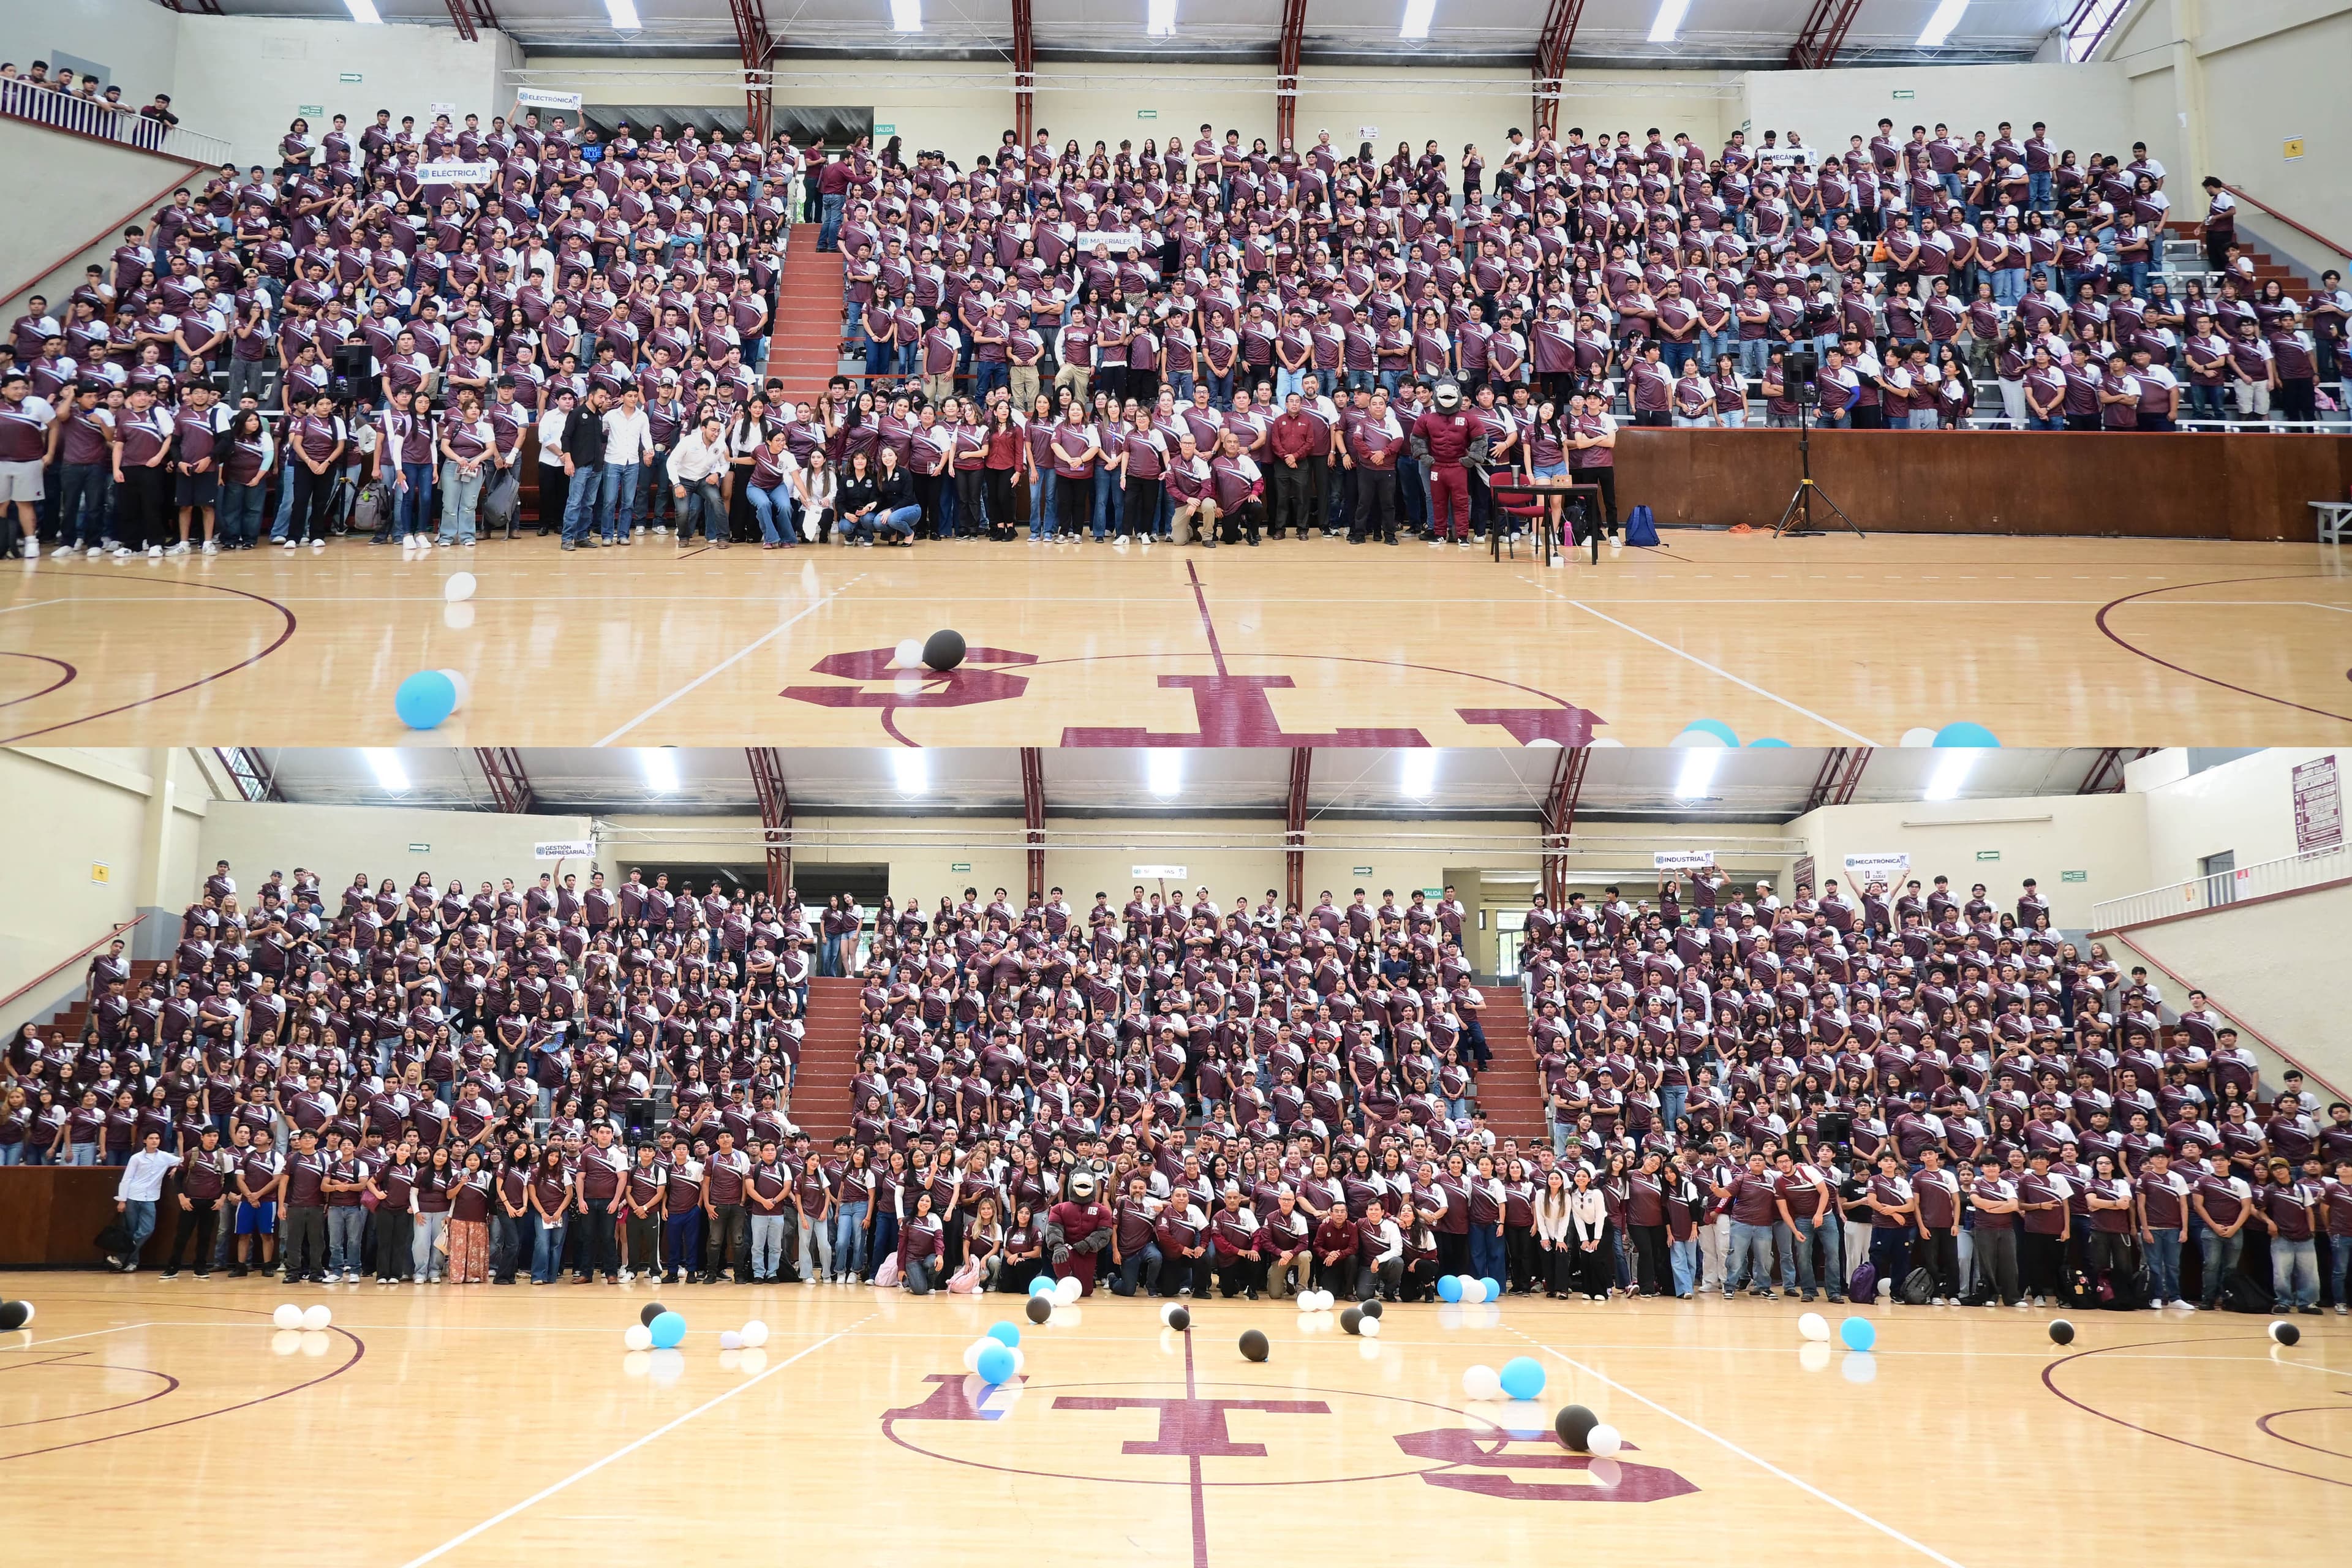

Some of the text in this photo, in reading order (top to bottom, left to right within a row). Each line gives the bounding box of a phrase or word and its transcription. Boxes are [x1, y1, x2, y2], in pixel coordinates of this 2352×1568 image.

[529, 94, 573, 104] ELECTRÓNICA
[1455, 417, 1466, 426] ITS
[1087, 1207, 1098, 1216] ITS
